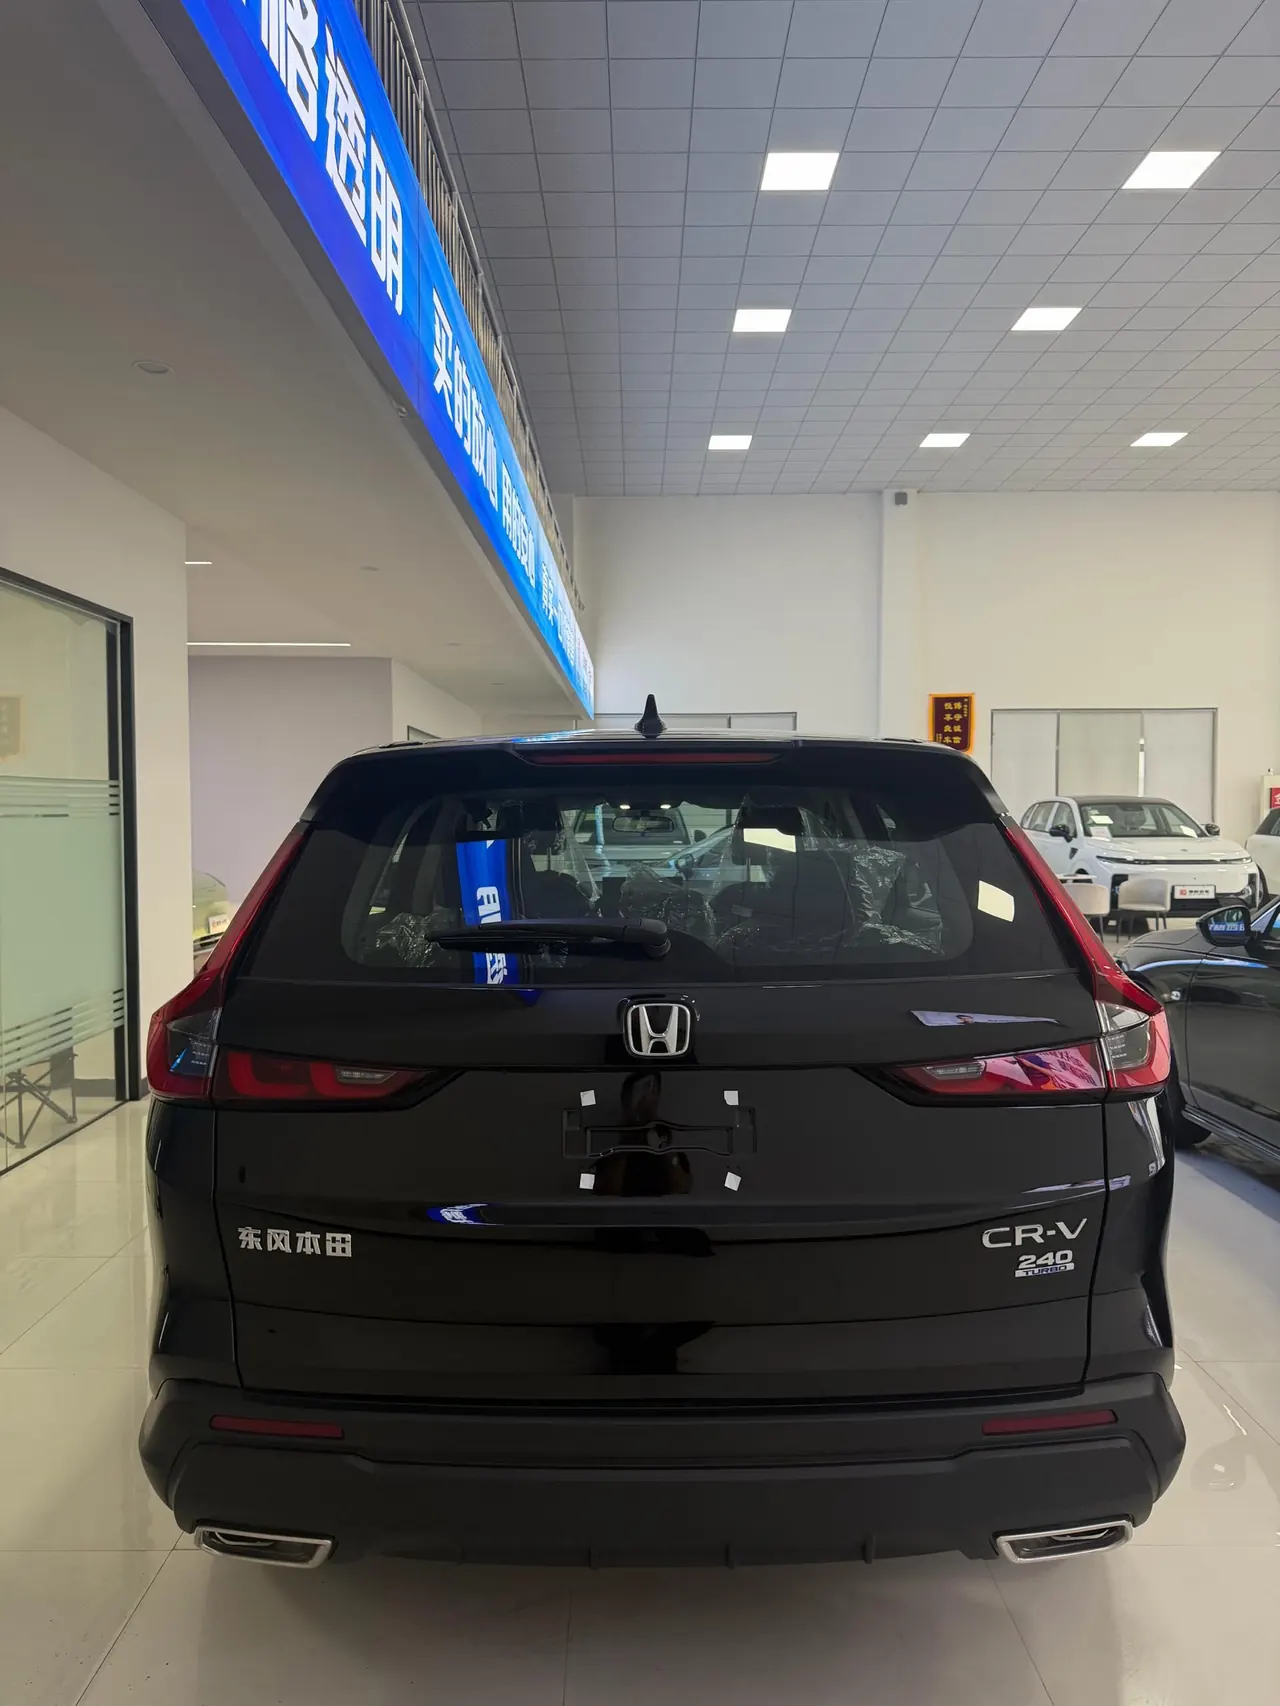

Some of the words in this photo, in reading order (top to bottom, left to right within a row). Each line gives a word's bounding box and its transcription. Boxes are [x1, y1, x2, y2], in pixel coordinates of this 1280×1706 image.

[241, 0, 403, 316] 格透明
[433, 286, 499, 512] 买的放心
[237, 1226, 352, 1258] 东风本田
[982, 1218, 1088, 1248] CR-V
[1018, 1250, 1073, 1269] 240
[1023, 1264, 1068, 1276] TURBO
